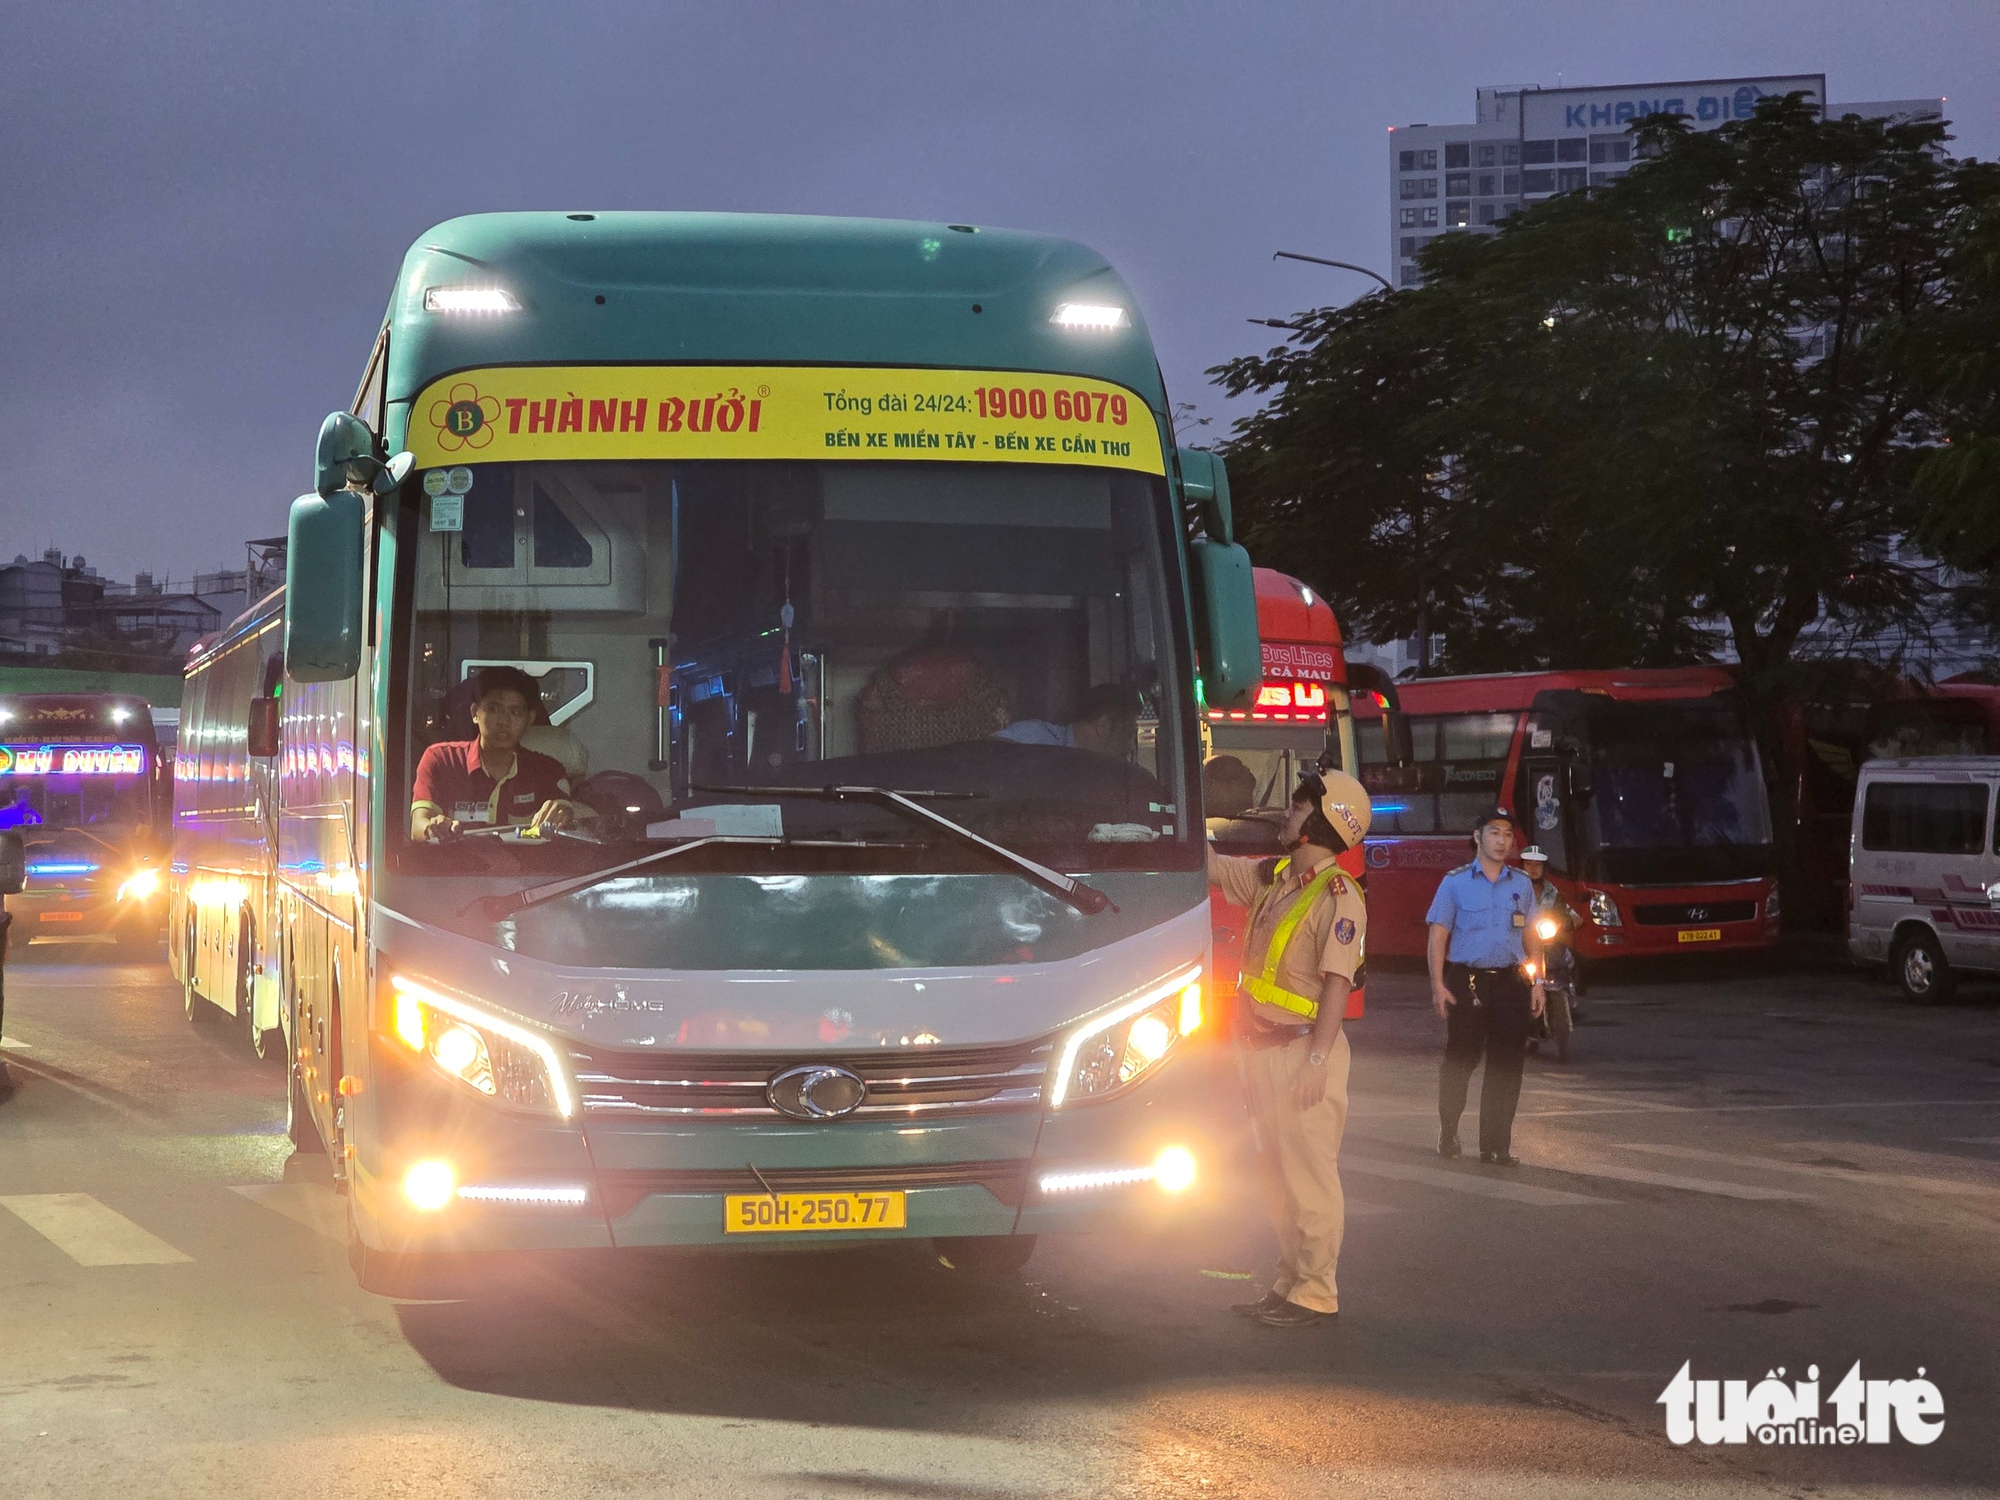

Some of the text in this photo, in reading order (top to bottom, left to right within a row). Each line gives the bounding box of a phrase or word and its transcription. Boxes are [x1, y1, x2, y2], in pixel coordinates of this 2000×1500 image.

[1696, 85, 1767, 120] ĐIỀ
[505, 387, 762, 434] THÀNH BƯỞI
[823, 387, 1128, 426] Tổng đài 24/24: 1900 6079
[825, 427, 860, 447] BẾN
[866, 432, 888, 448] XE
[894, 428, 940, 449] MIỀN
[945, 431, 977, 449] TÂY
[994, 431, 1029, 451] BẾN
[1035, 436, 1056, 452] XE
[1062, 433, 1097, 454] CẦN
[1100, 440, 1131, 457] THƠ
[1261, 643, 1334, 669] Bus Lines
[1271, 666, 1293, 677] CÀ
[1297, 668, 1332, 681] MAU
[740, 1197, 891, 1227] 50H-250.77
